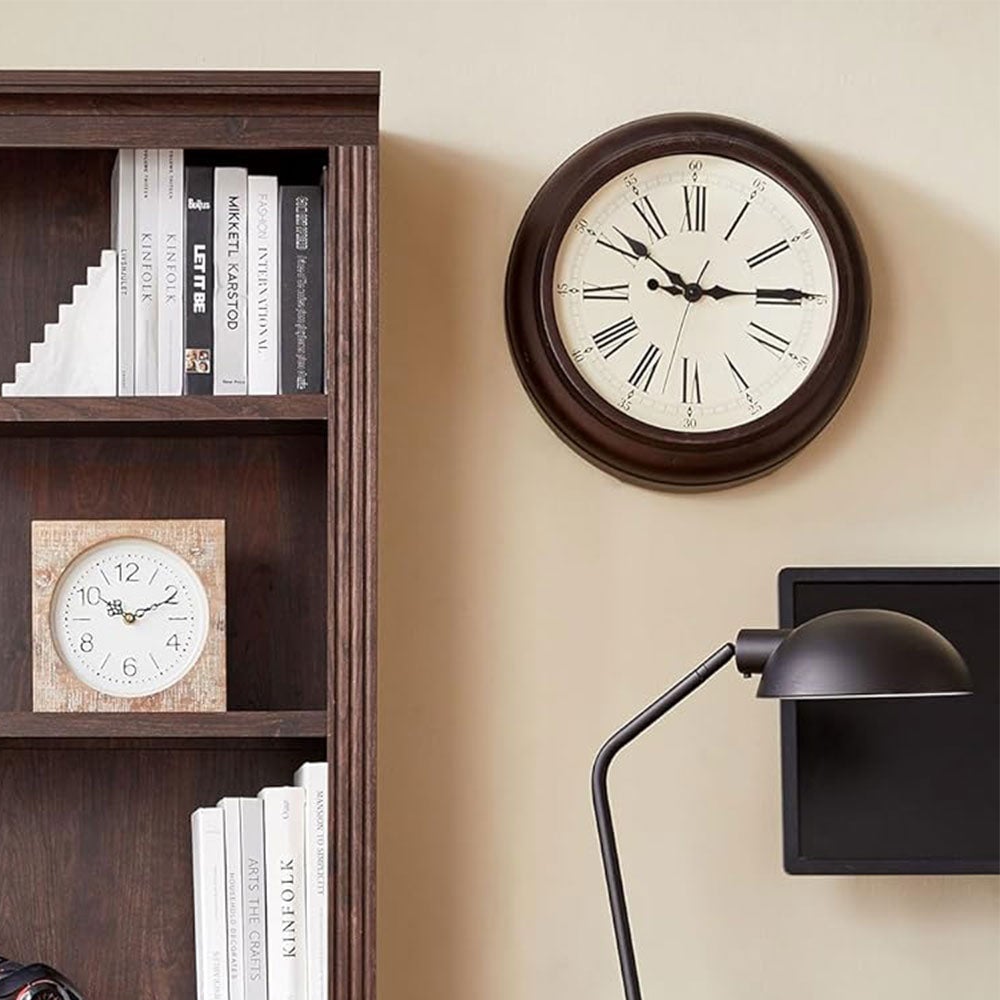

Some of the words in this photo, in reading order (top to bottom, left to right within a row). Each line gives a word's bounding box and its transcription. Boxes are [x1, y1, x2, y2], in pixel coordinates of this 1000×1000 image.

[688, 160, 703, 171] 60
[623, 174, 639, 188] 55
[257, 193, 269, 239] FASHION
[631, 195, 668, 244] XI
[680, 185, 707, 233] XII
[228, 195, 240, 257] MIKKETL
[142, 233, 152, 302] KINFOLK
[166, 234, 177, 304] KINFOLK
[193, 244, 206, 273] LET
[193, 275, 206, 290] IT
[193, 292, 206, 314] BE
[227, 263, 239, 330] KARSTOD
[257, 247, 269, 354] INTERNATIONAL
[683, 418, 697, 429] 30
[115, 562, 140, 582] 12
[77, 586, 102, 606] 10
[164, 585, 179, 605] 2
[80, 632, 94, 653] 8
[166, 634, 182, 651] 4
[123, 657, 138, 677] 6
[317, 834, 324, 846] TO
[248, 858, 259, 892] ARTS
[249, 898, 260, 924] THE
[280, 858, 297, 958] KINFOLK
[250, 930, 261, 982] CRAFTS
